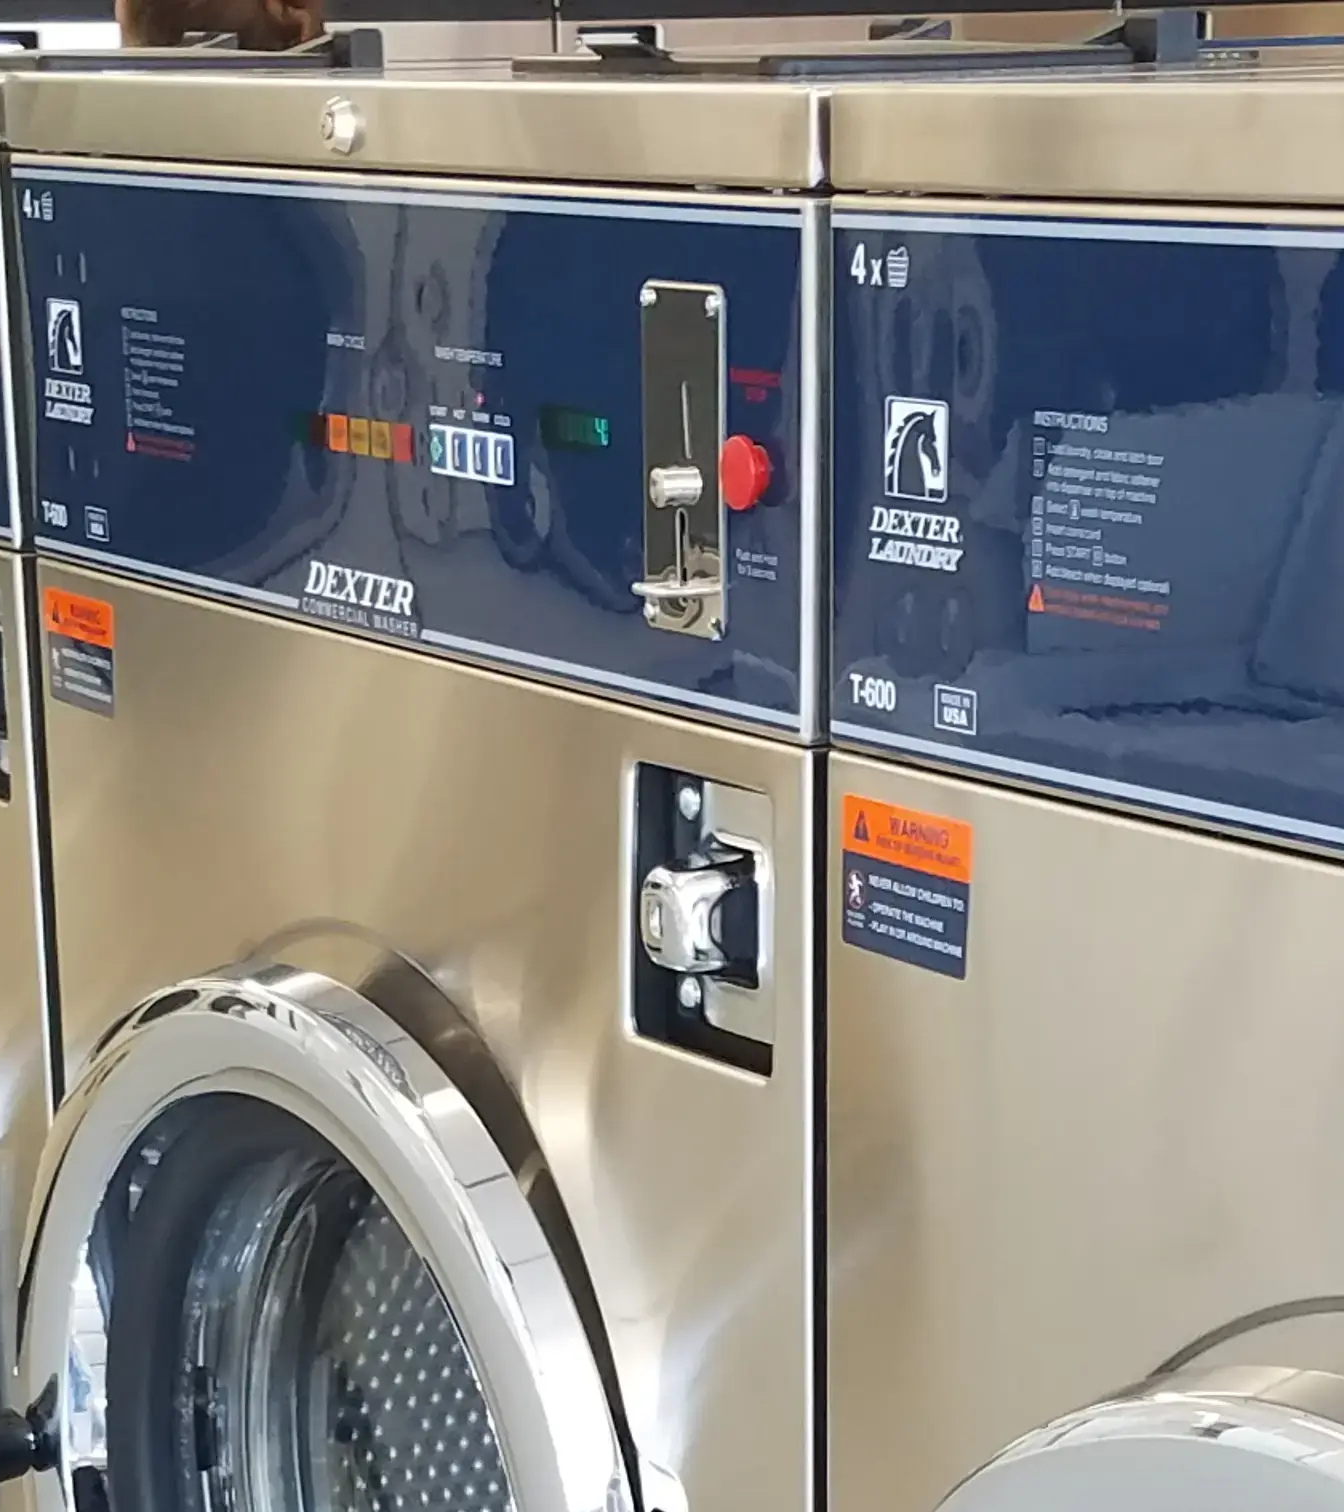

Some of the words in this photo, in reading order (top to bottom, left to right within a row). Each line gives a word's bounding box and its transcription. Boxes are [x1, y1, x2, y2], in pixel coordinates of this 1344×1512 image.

[868, 505, 961, 544] DEXTER
[867, 537, 965, 572] LAUNDRY
[303, 559, 415, 617] DEXTER
[849, 672, 897, 713] T-600
[943, 706, 969, 727] USA
